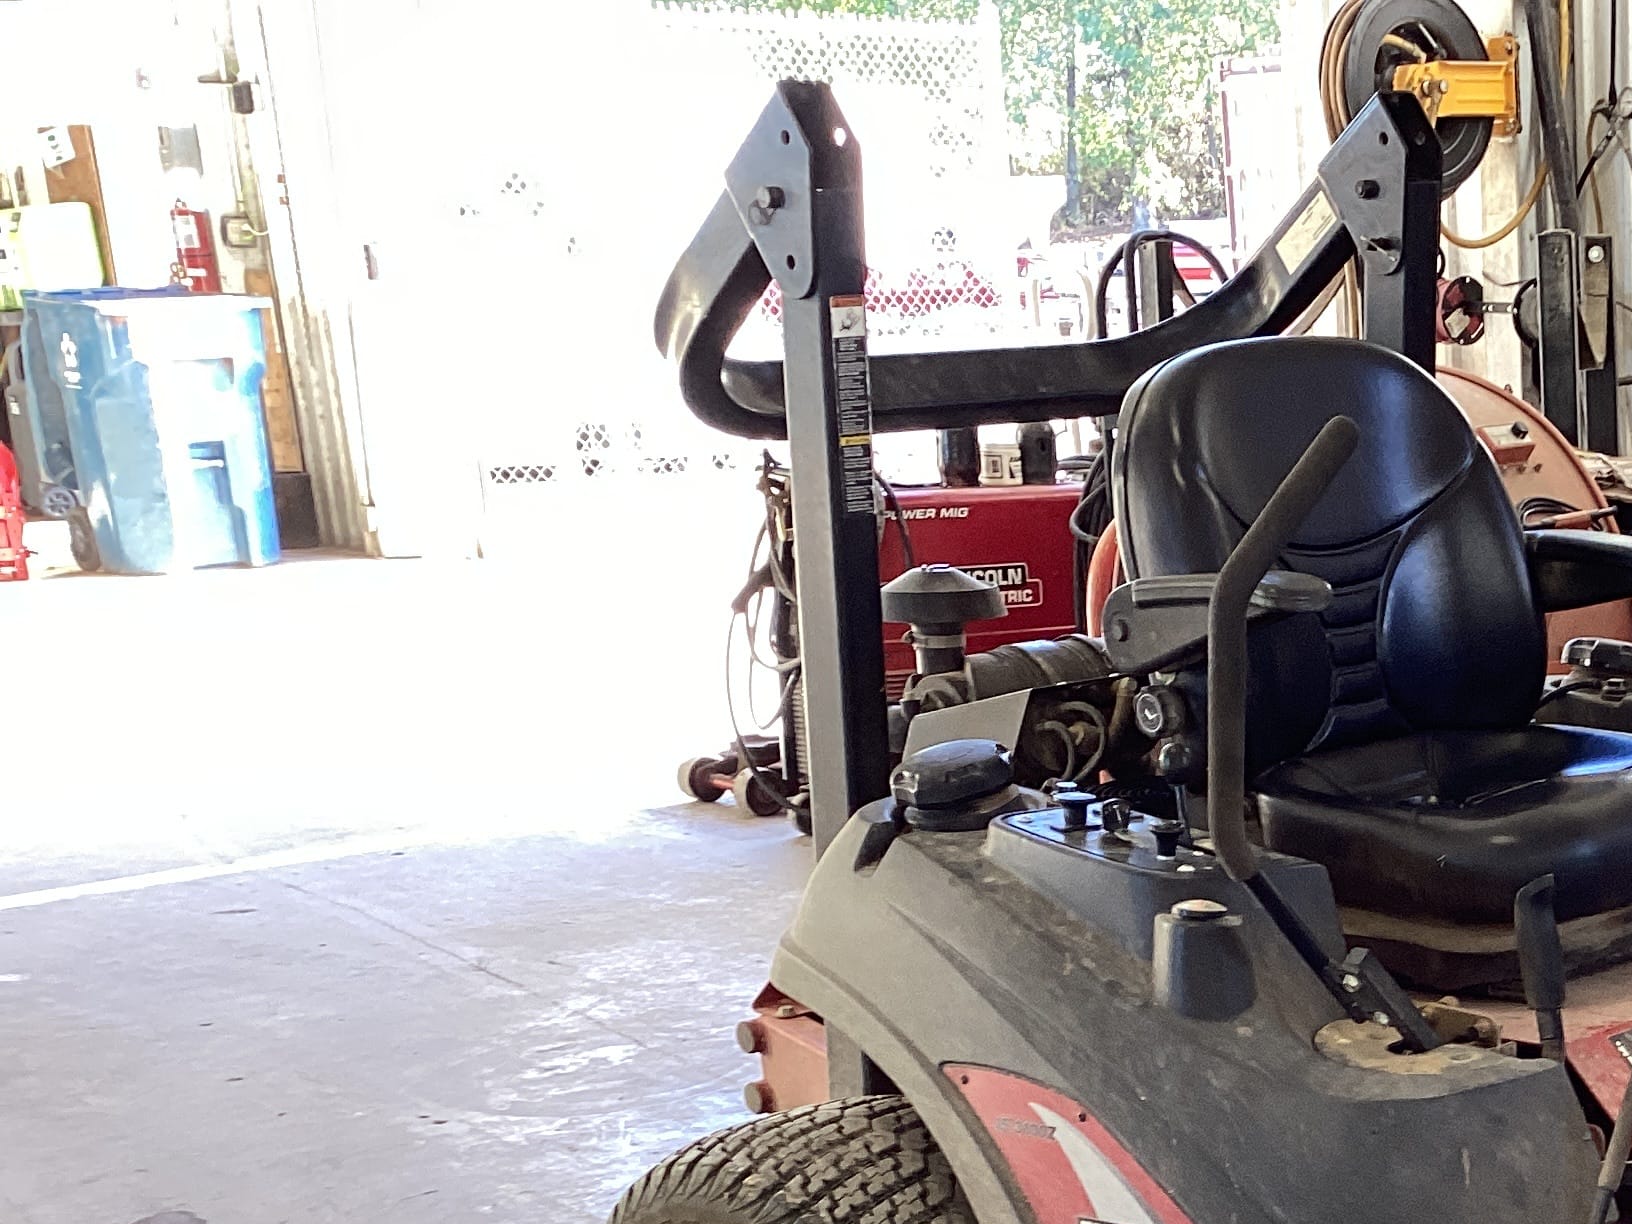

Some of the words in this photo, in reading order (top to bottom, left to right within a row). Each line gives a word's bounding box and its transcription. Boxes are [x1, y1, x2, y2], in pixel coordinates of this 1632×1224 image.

[940, 507, 969, 518] MIG
[971, 568, 1023, 587] COLN
[1000, 589, 1033, 603] TRIC
